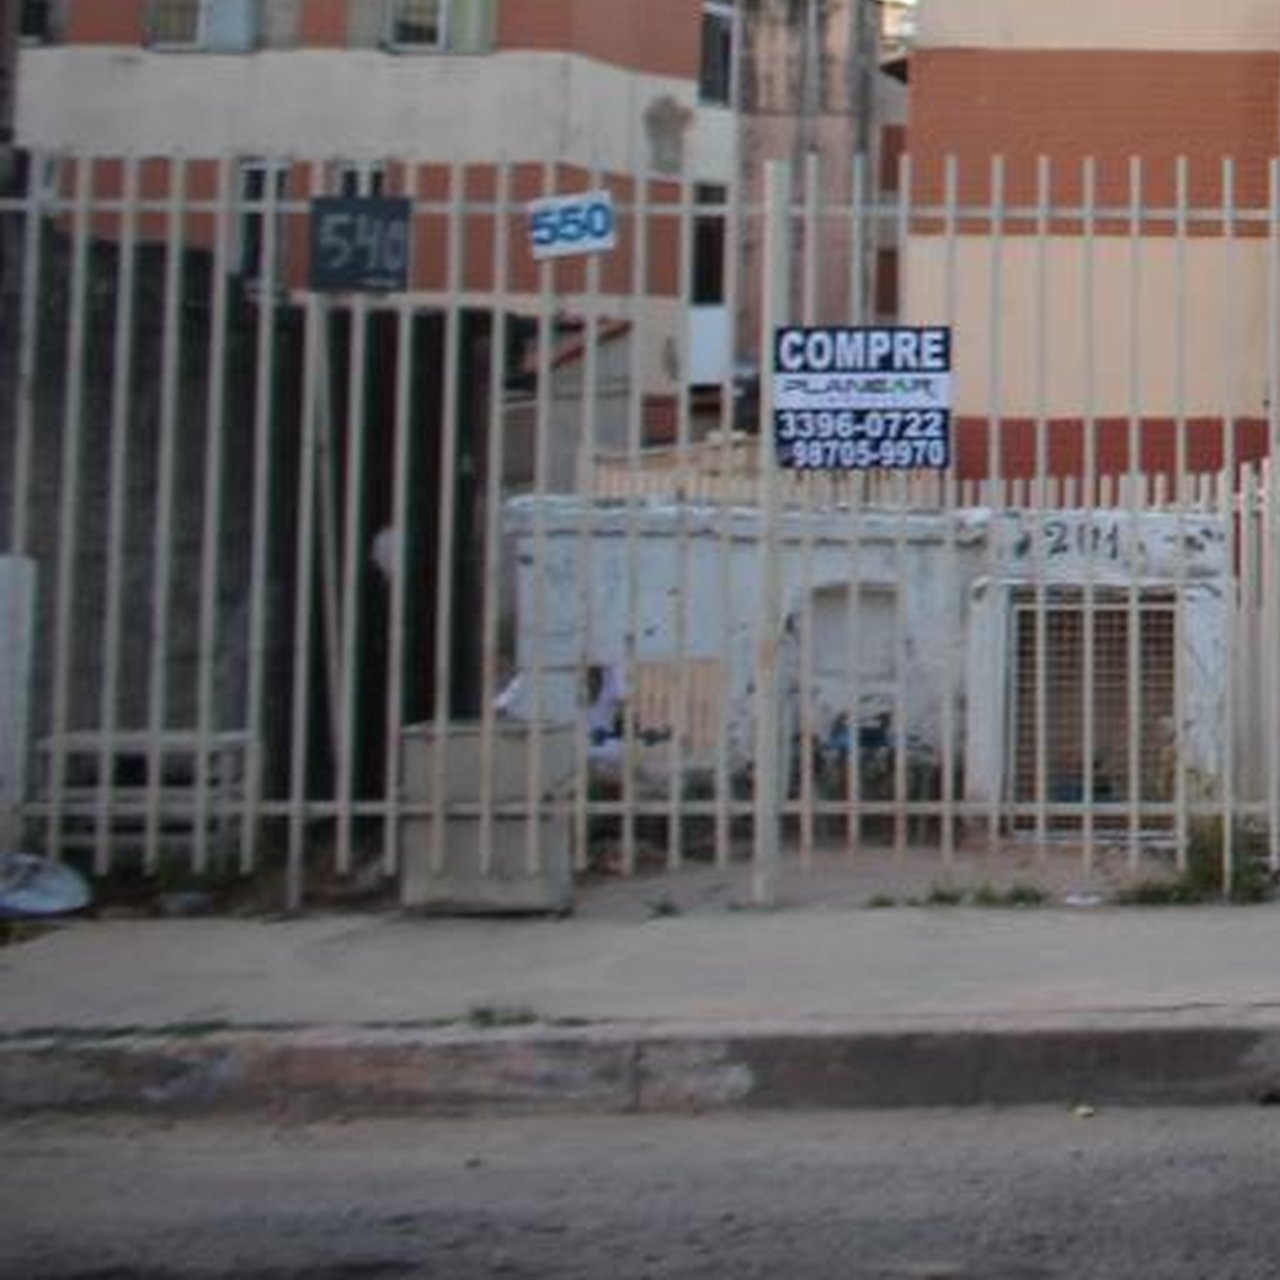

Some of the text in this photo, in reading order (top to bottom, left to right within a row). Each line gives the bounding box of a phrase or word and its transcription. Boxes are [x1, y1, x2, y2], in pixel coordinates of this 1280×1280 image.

[531, 203, 611, 245] 550
[780, 330, 945, 370] COMPRE
[779, 411, 943, 438] 3396-0722
